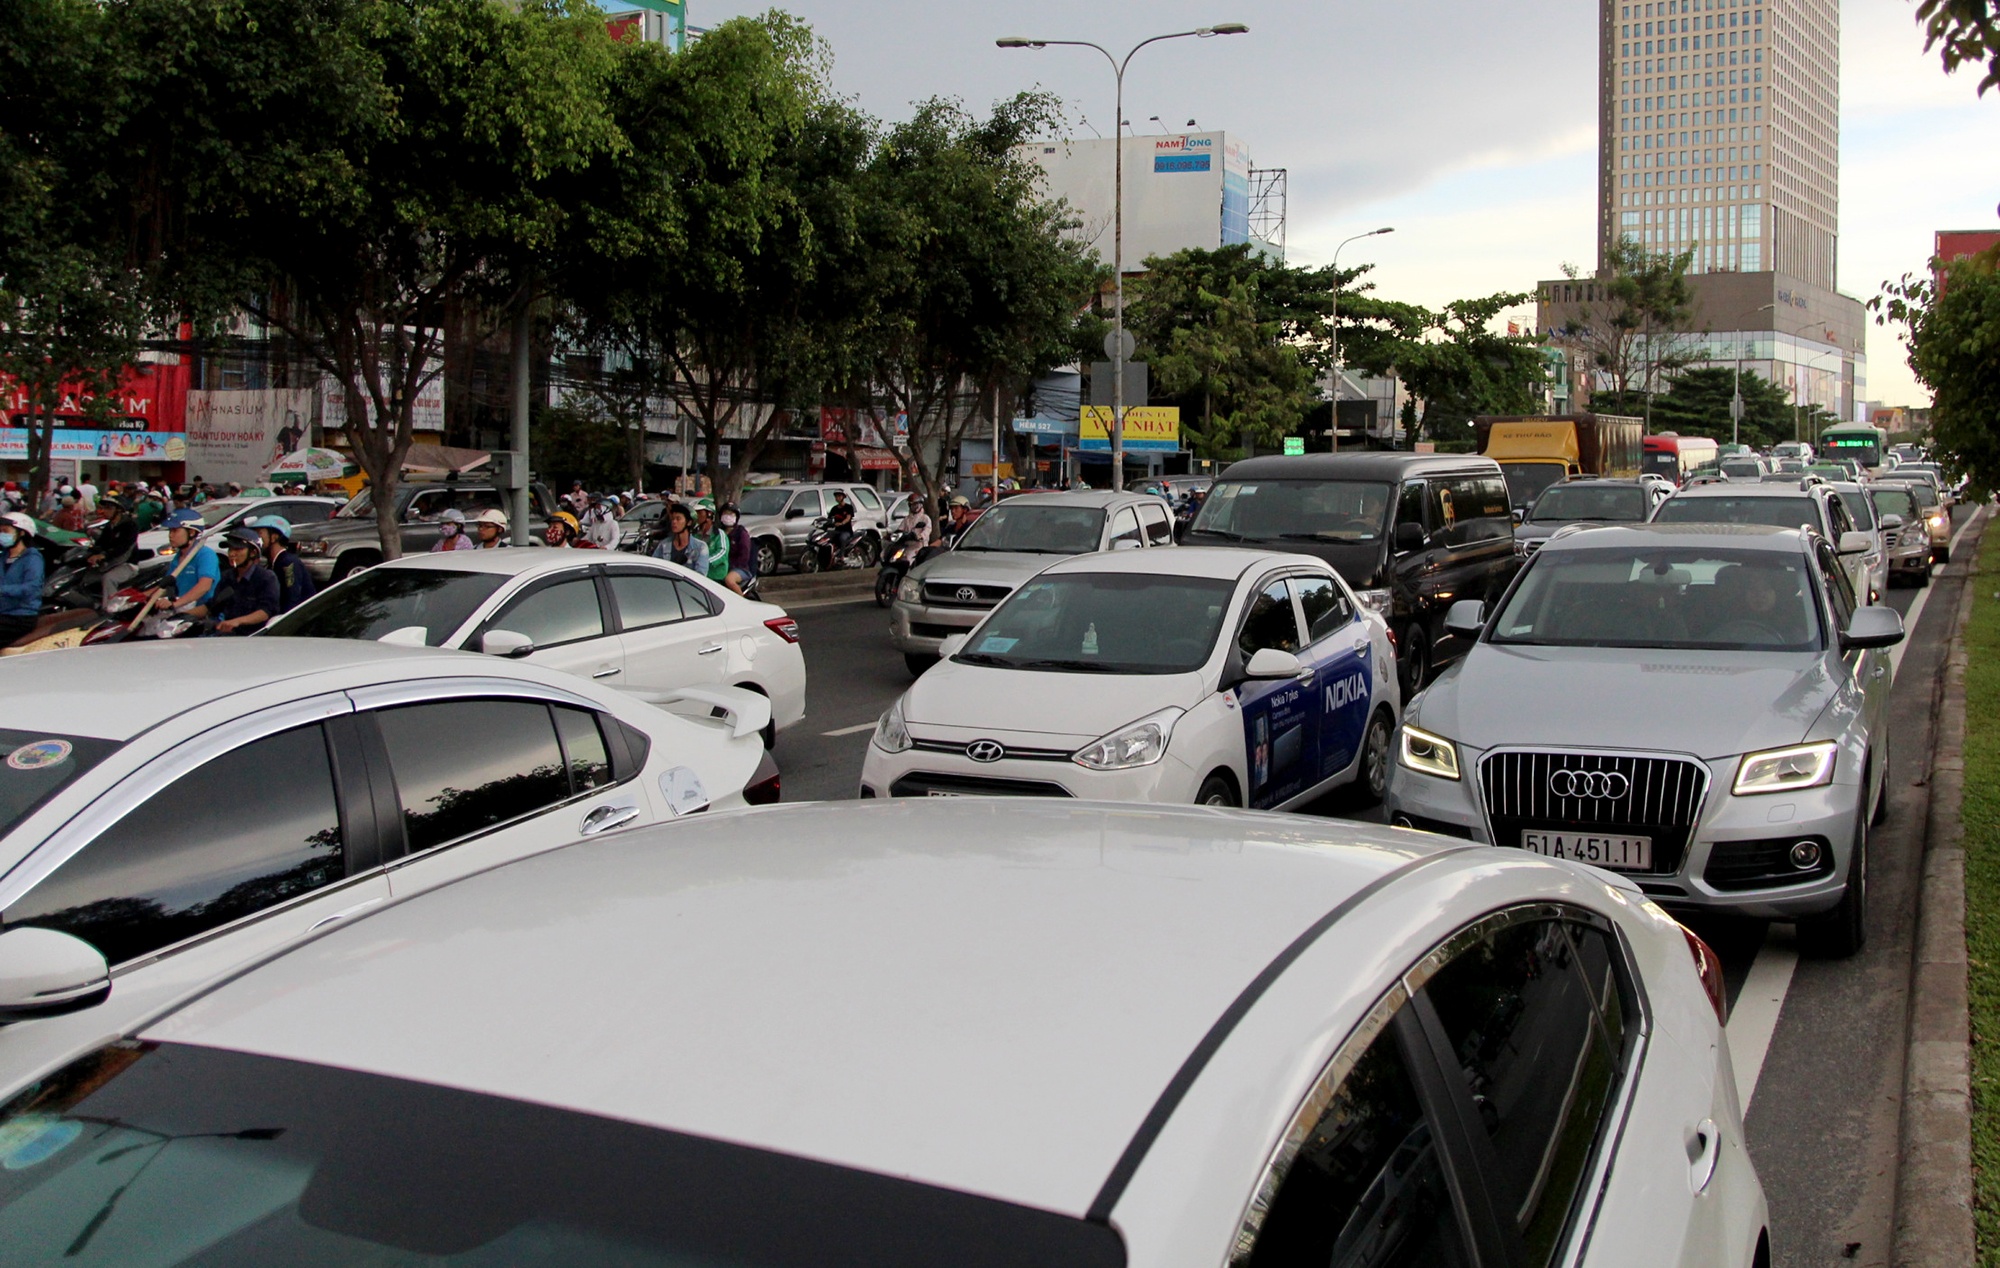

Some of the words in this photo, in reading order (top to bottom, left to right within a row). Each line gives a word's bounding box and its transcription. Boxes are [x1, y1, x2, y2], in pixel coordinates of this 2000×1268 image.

[1271, 691, 1286, 708] Nokia
[1289, 689, 1299, 704] plus
[1326, 672, 1369, 713] NOKIA
[1526, 834, 1642, 864] 51A-451.11
